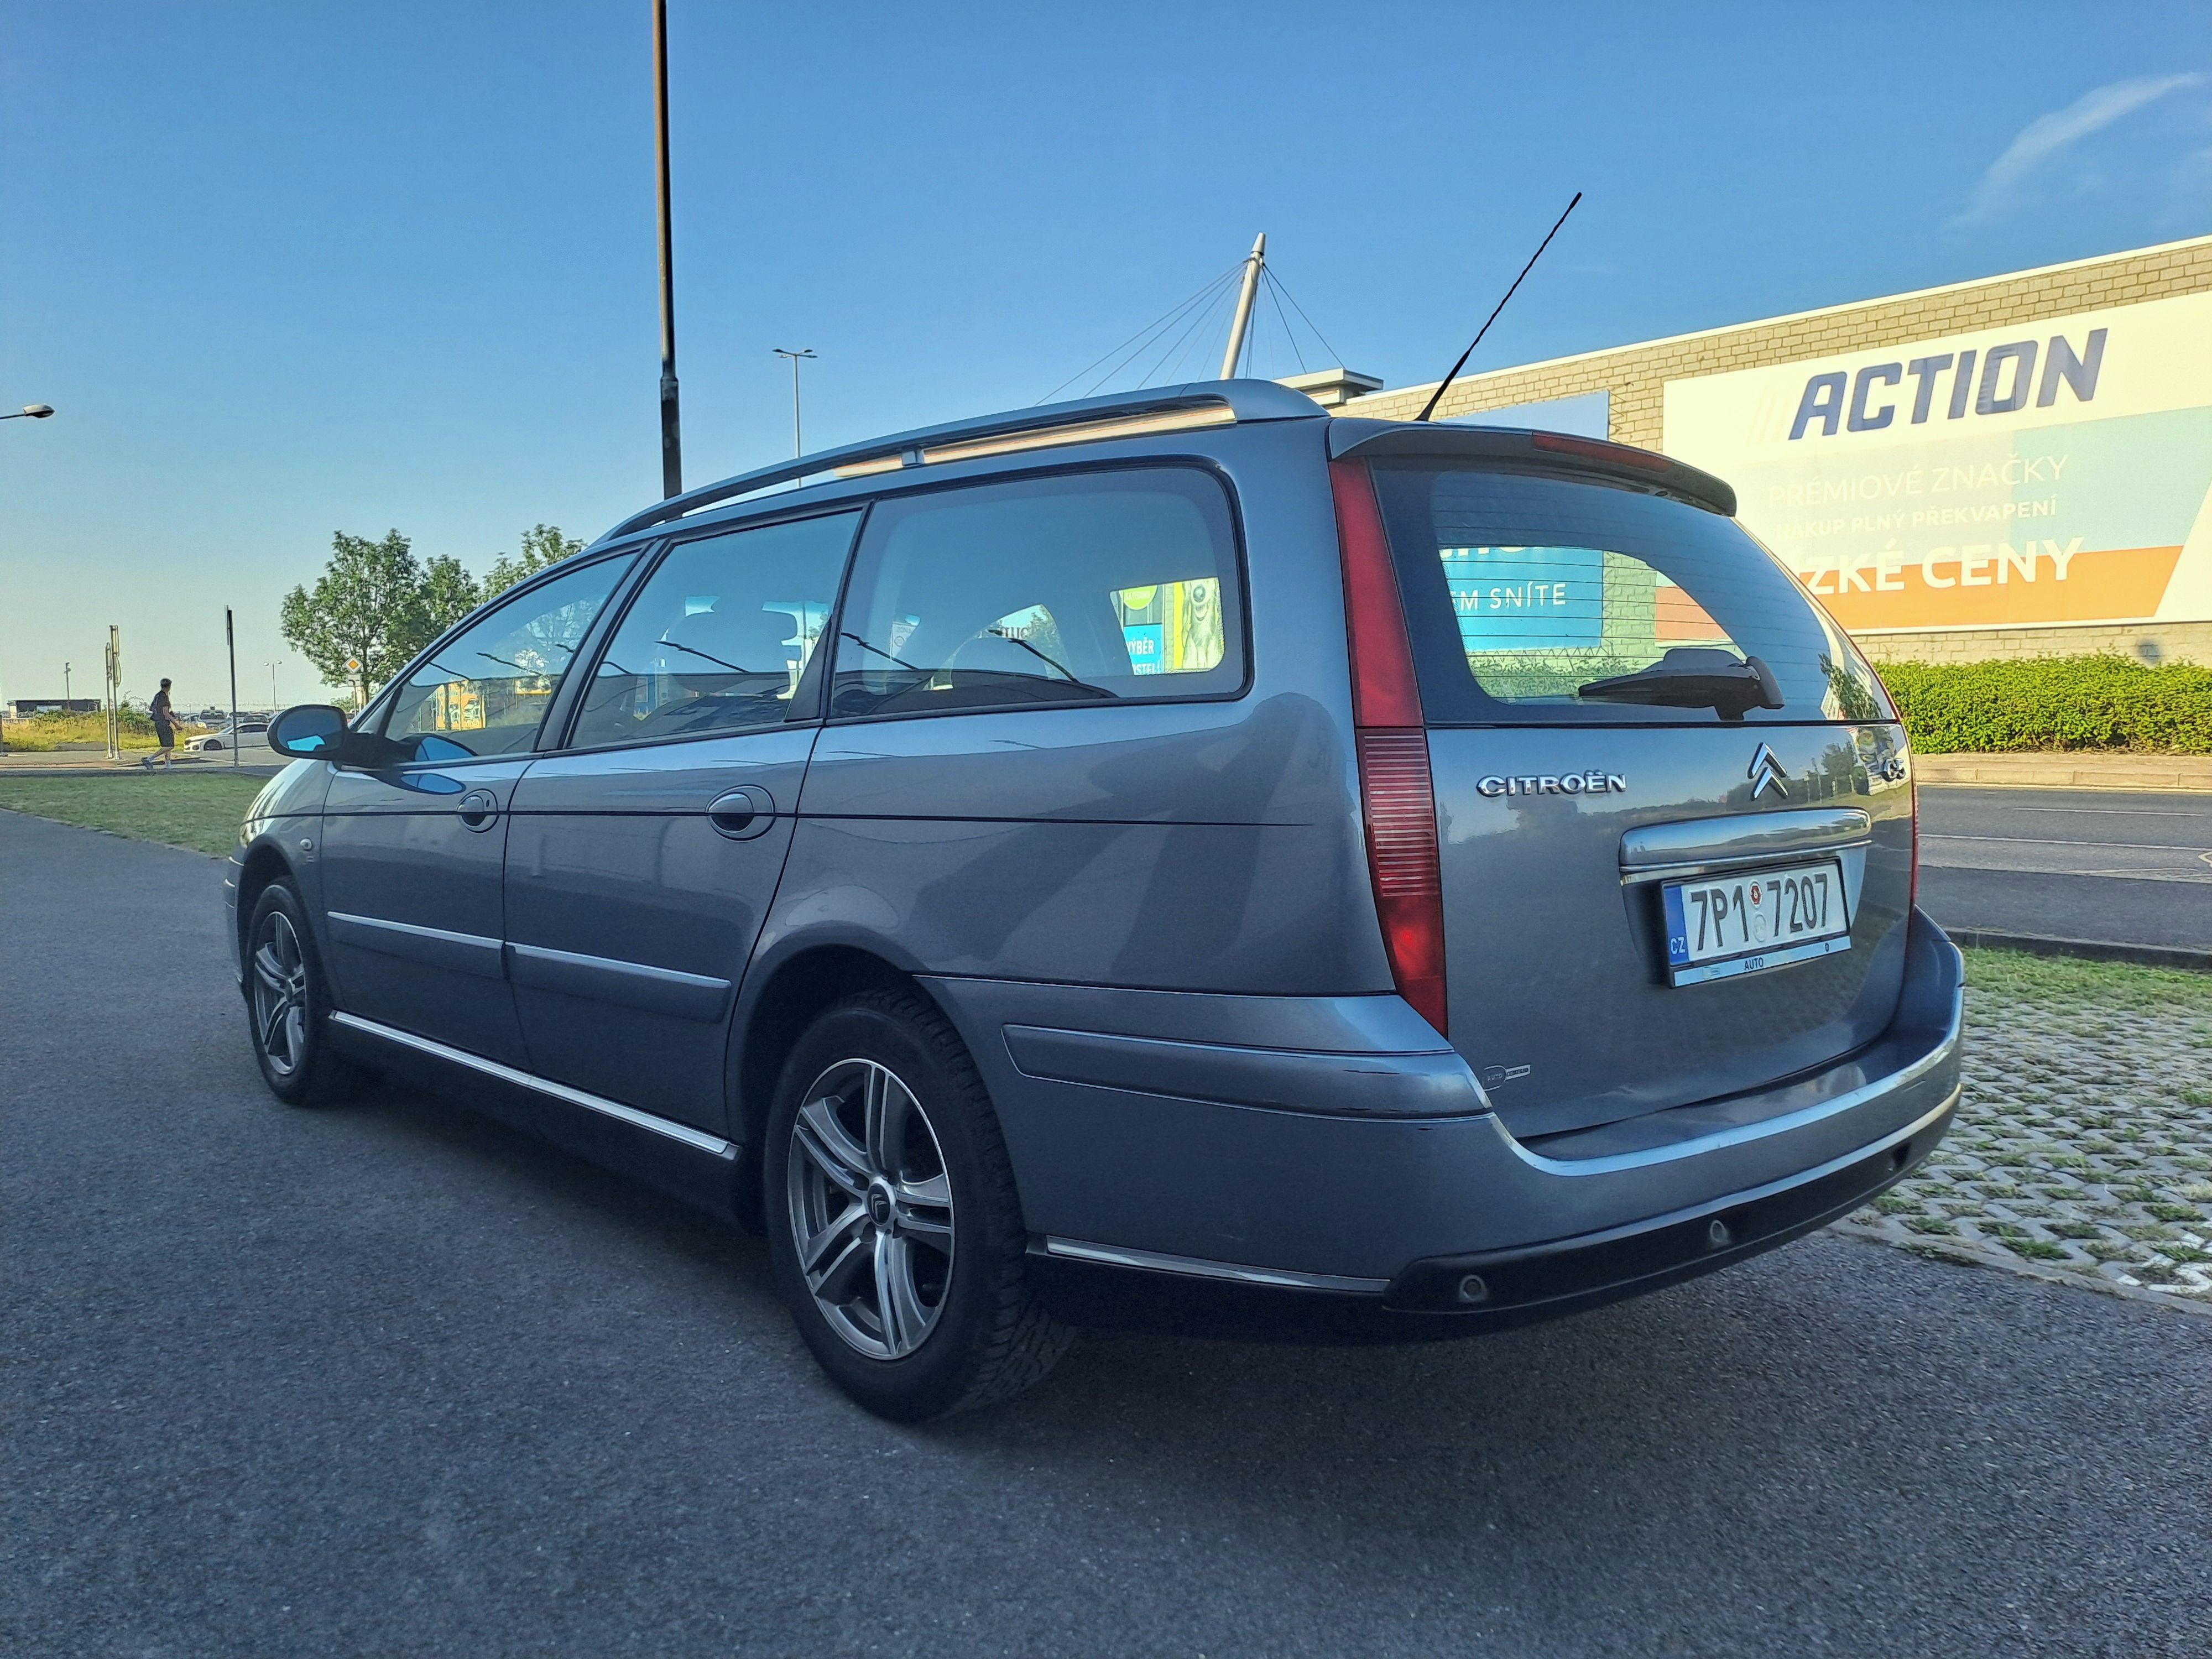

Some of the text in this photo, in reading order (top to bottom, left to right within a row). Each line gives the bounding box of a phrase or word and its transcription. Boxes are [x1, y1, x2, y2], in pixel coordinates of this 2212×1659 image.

[1788, 328, 2108, 440] ACTION
[1771, 452, 2069, 508] PRÉMIOVÉ ZNAČKY
[1776, 494, 2058, 540] NÁKUP PLNÝ PŘEKVAPENÍ
[1922, 536, 2085, 589] CENY
[1490, 581, 1567, 609] SNÍTE
[1476, 769, 1626, 797] CITROËN
[1883, 757, 1906, 782] C5
[1691, 873, 1828, 951] 7P1 7207
[1670, 937, 1686, 955] CZ
[1744, 957, 1764, 971] AUTO
